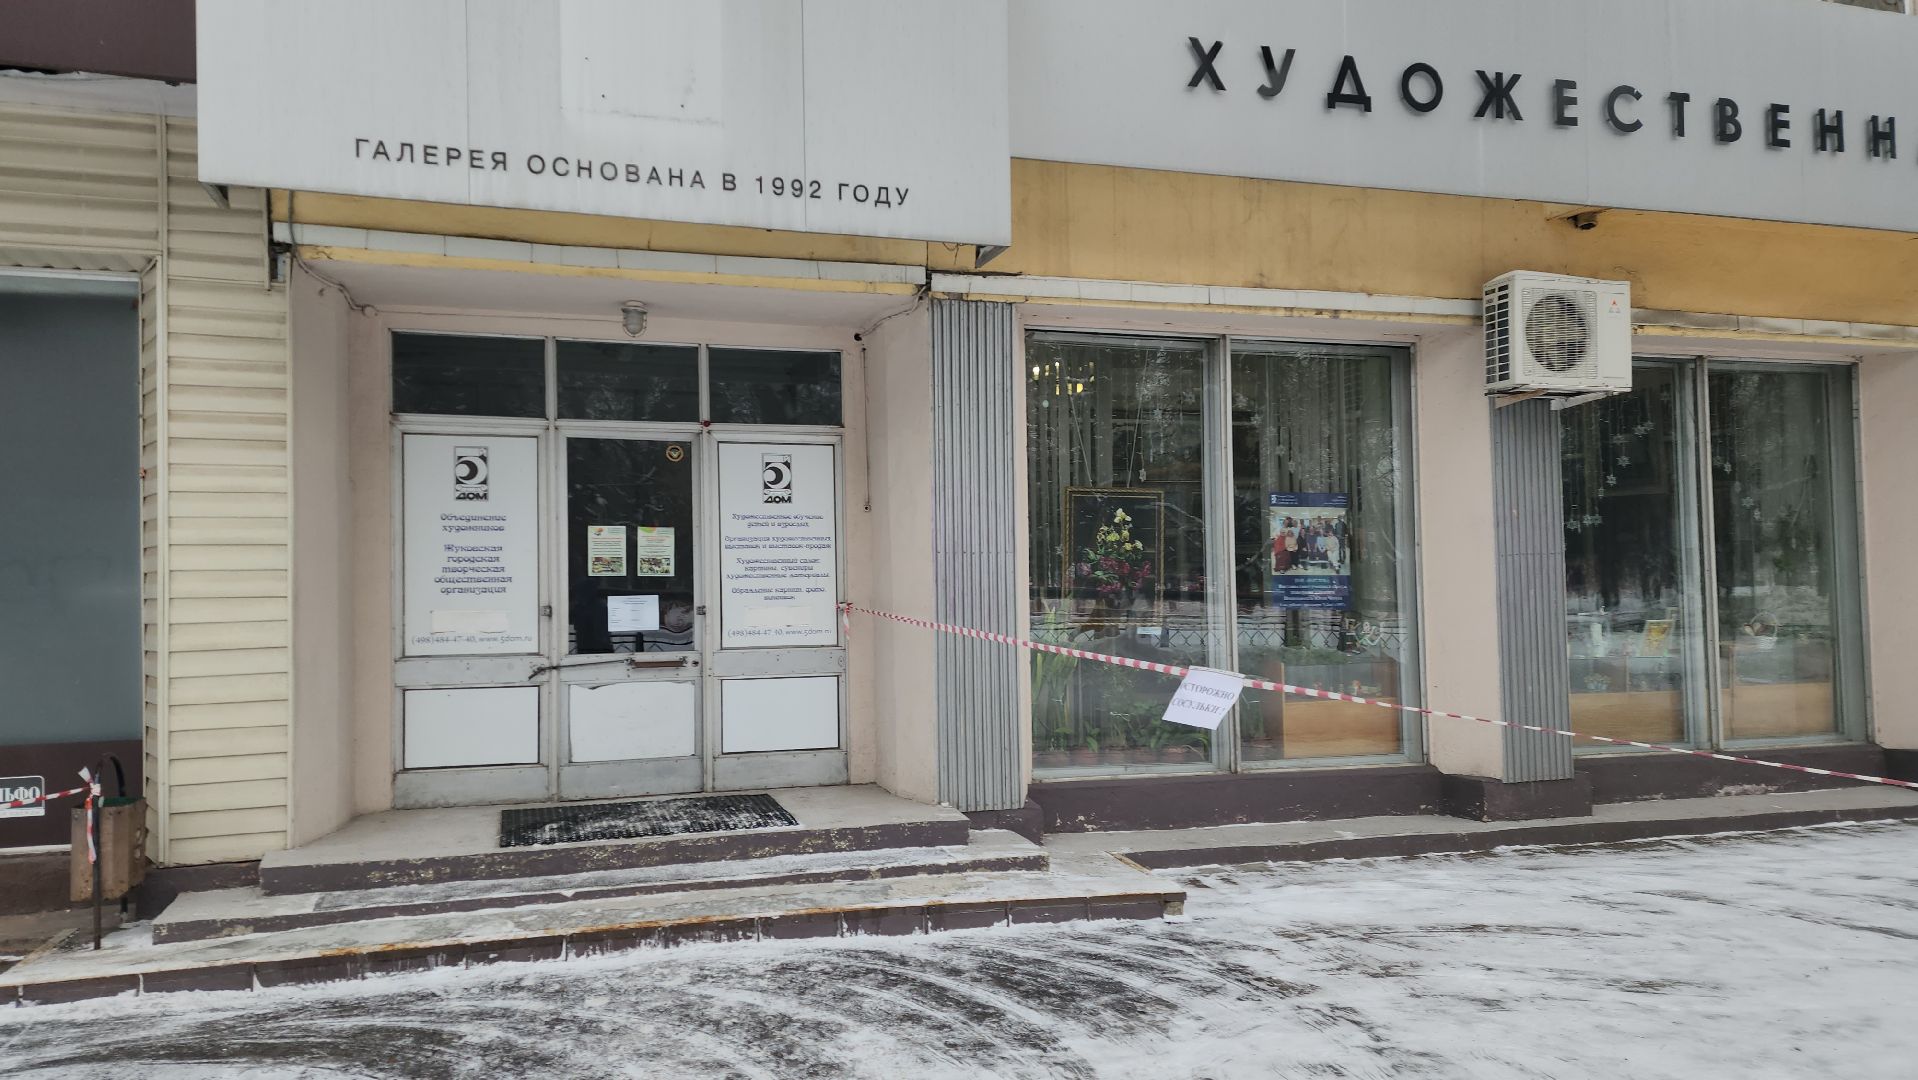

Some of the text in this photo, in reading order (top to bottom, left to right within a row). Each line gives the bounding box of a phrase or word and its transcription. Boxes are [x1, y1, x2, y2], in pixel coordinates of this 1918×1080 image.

[1187, 36, 1899, 160] ХУДОЖЕСТВЕНН
[354, 137, 910, 208] ГАЛЕРЕЯ ОСНОВАНА В 1992 ГОДУ
[455, 492, 488, 501] ДОМ
[763, 495, 792, 504] ДОМ
[440, 513, 507, 523] Объединение
[442, 525, 505, 533] художников
[443, 544, 503, 553] Жуковская
[446, 556, 500, 564] городская
[441, 566, 505, 574] творческая
[433, 575, 513, 584] общественная
[440, 587, 507, 595] организация
